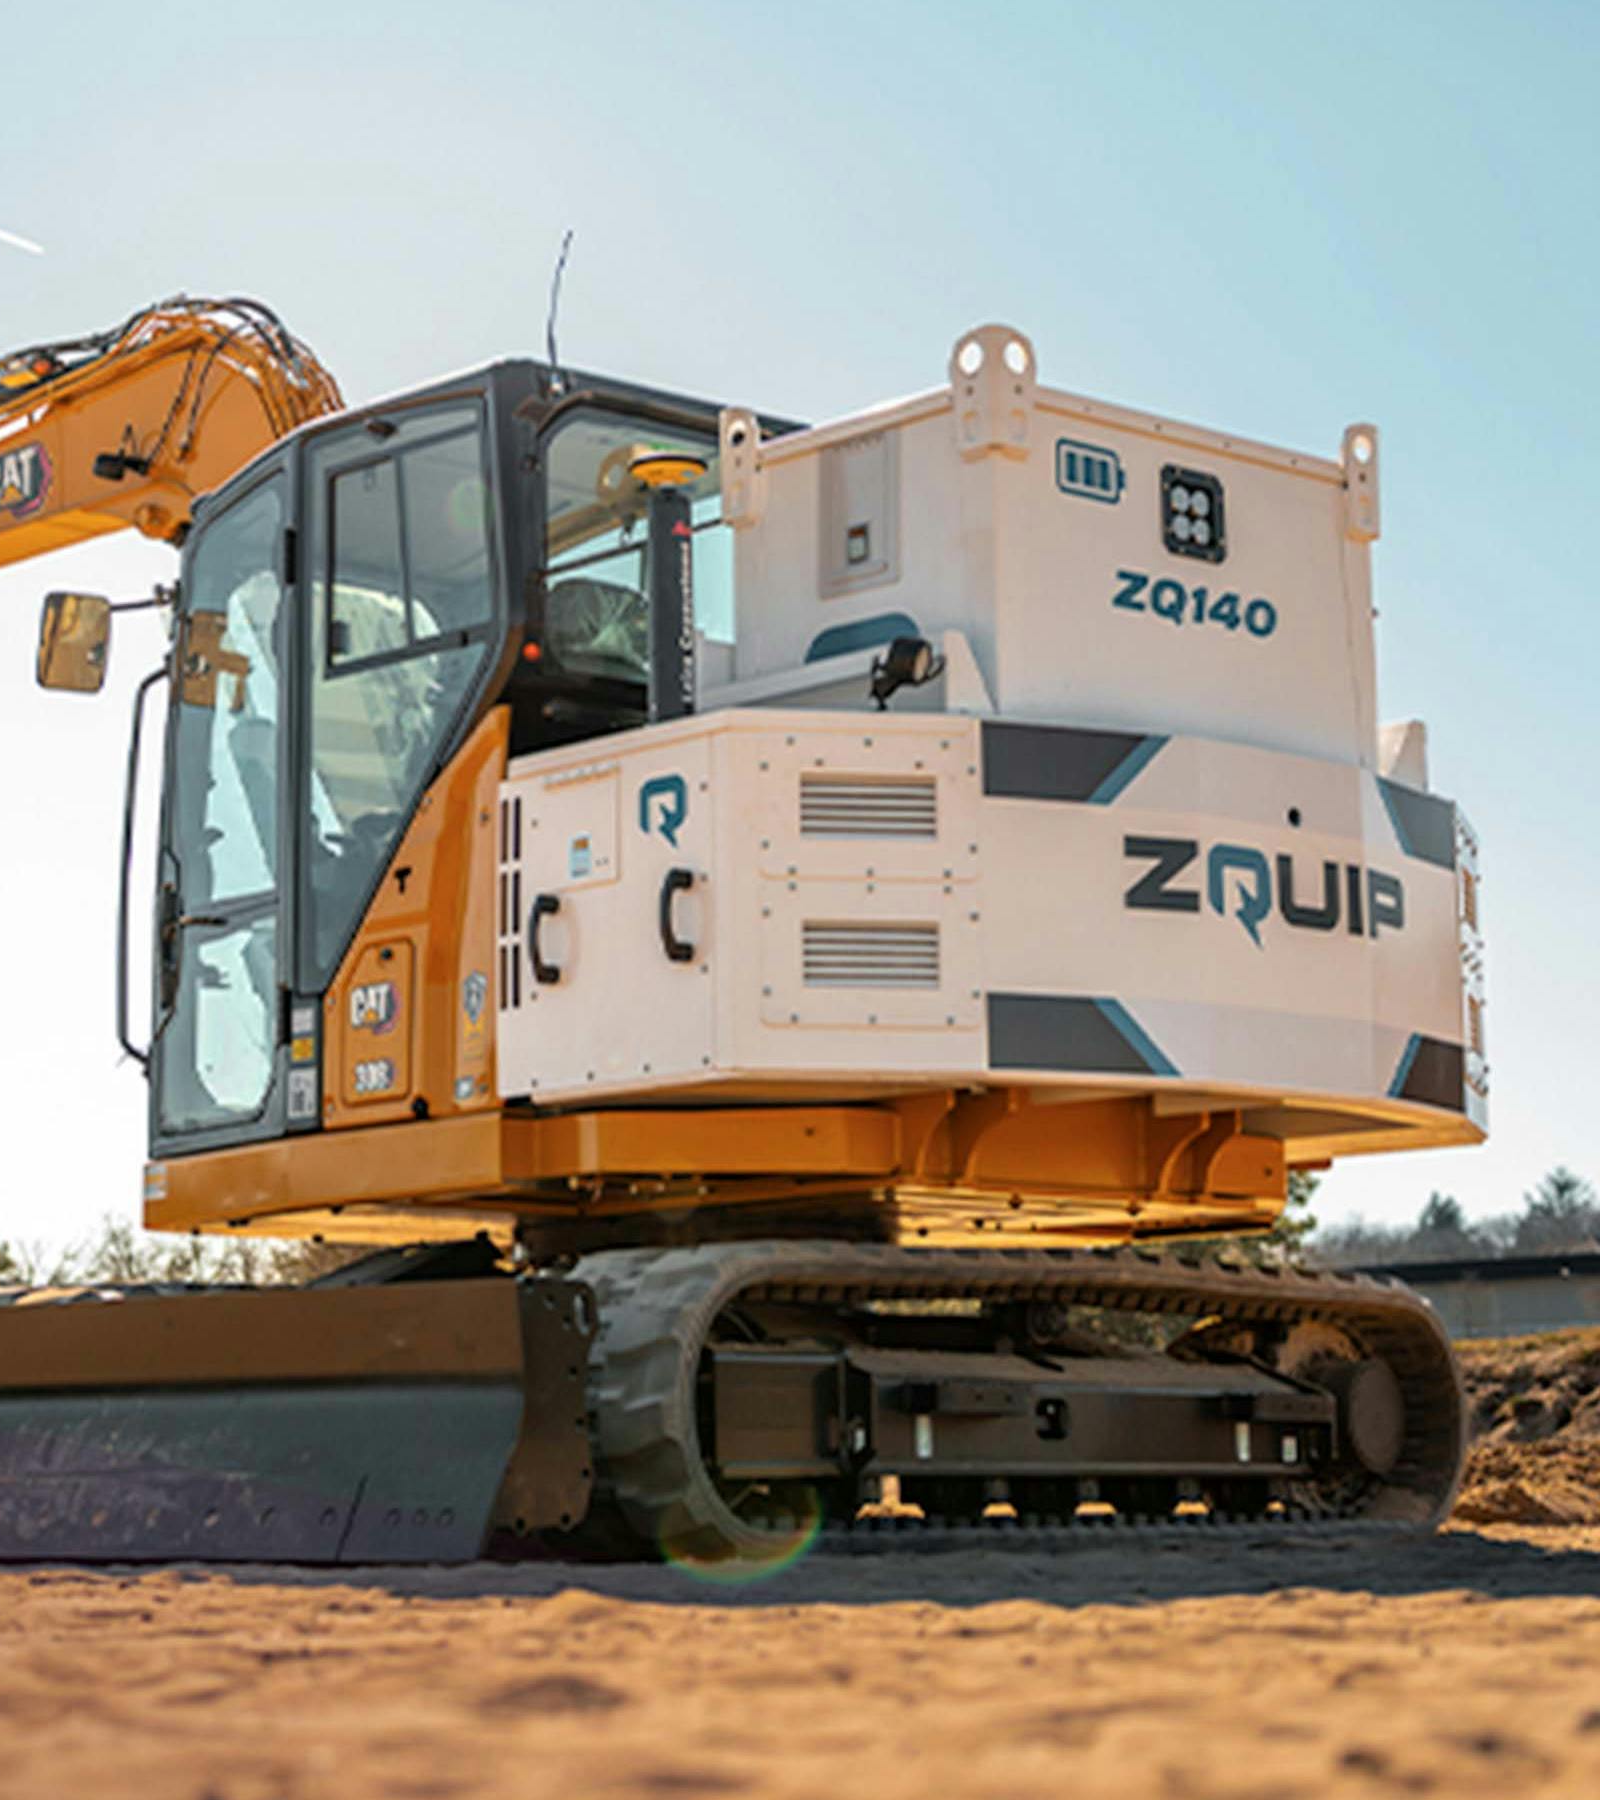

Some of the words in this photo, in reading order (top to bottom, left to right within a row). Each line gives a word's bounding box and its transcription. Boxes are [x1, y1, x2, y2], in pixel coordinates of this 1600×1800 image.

[1111, 569, 1278, 638] ZQ140
[1123, 834, 1404, 950] ZQUIP
[350, 982, 391, 1029] CAT
